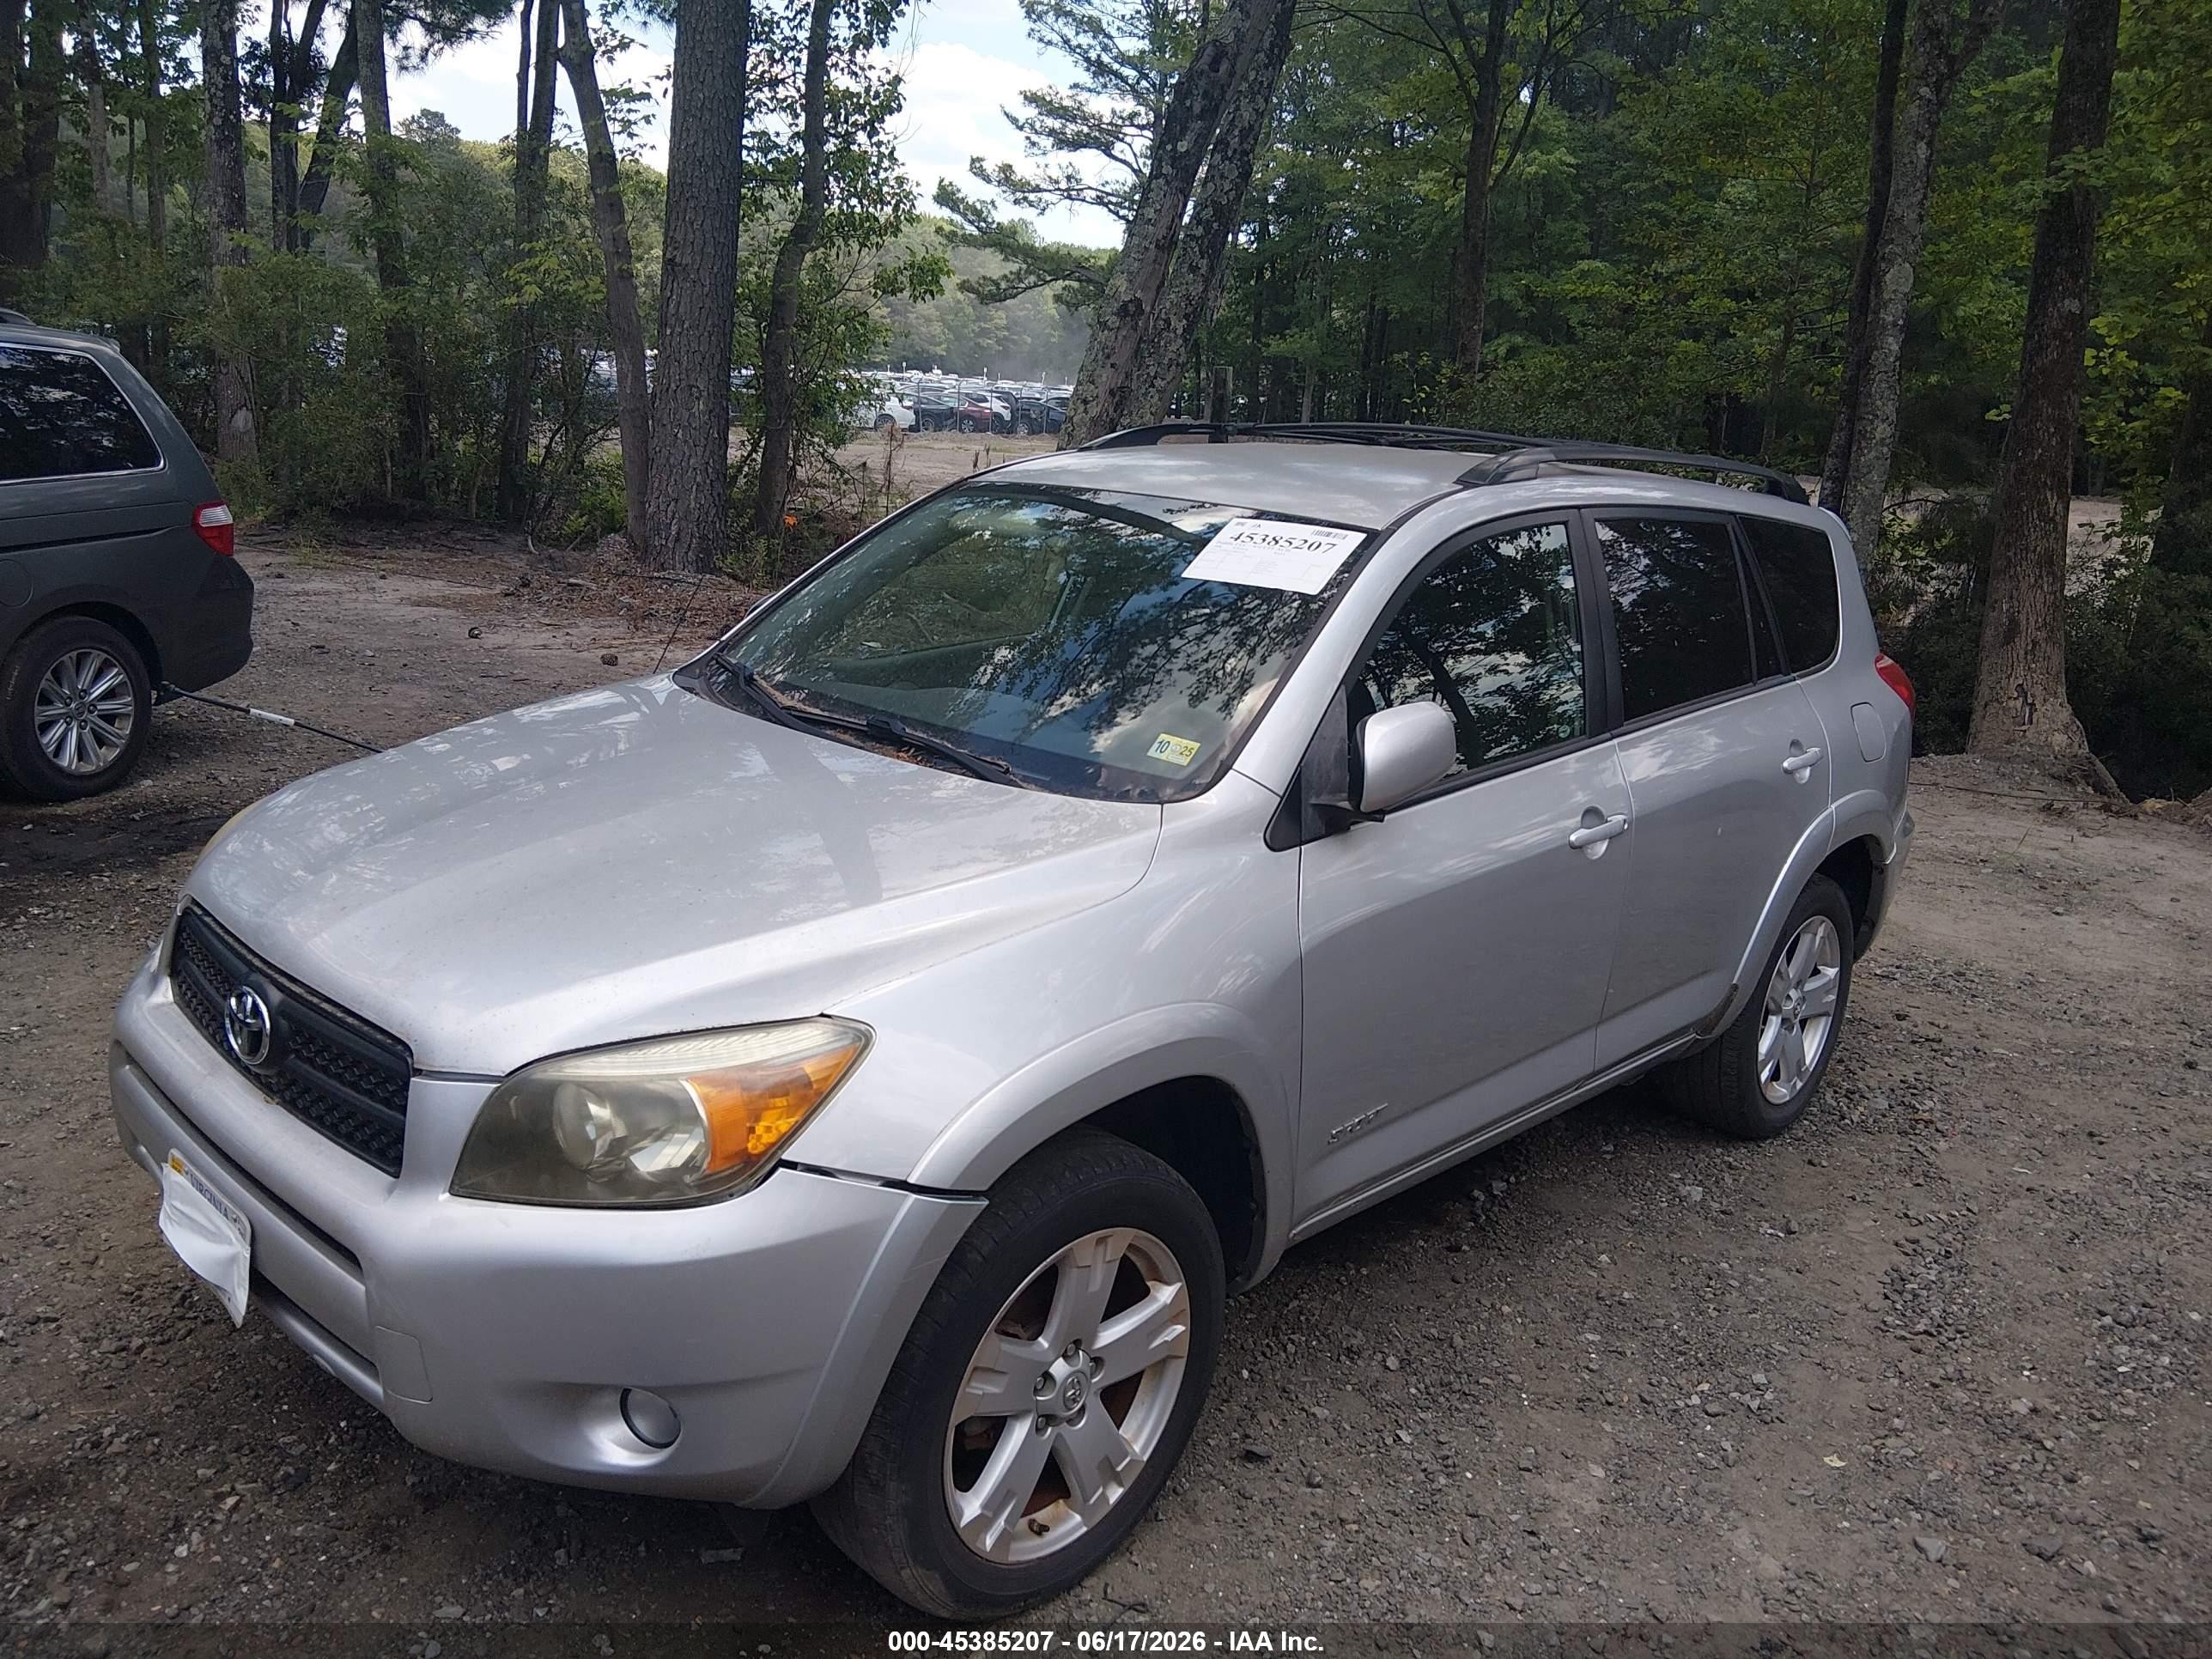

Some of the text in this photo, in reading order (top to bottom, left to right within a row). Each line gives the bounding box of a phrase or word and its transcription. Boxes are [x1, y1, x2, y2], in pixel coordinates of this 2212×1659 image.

[1230, 532, 1339, 554] 45385207
[1155, 738, 1195, 757] 10 25
[190, 1173, 229, 1220] VIRGINIA
